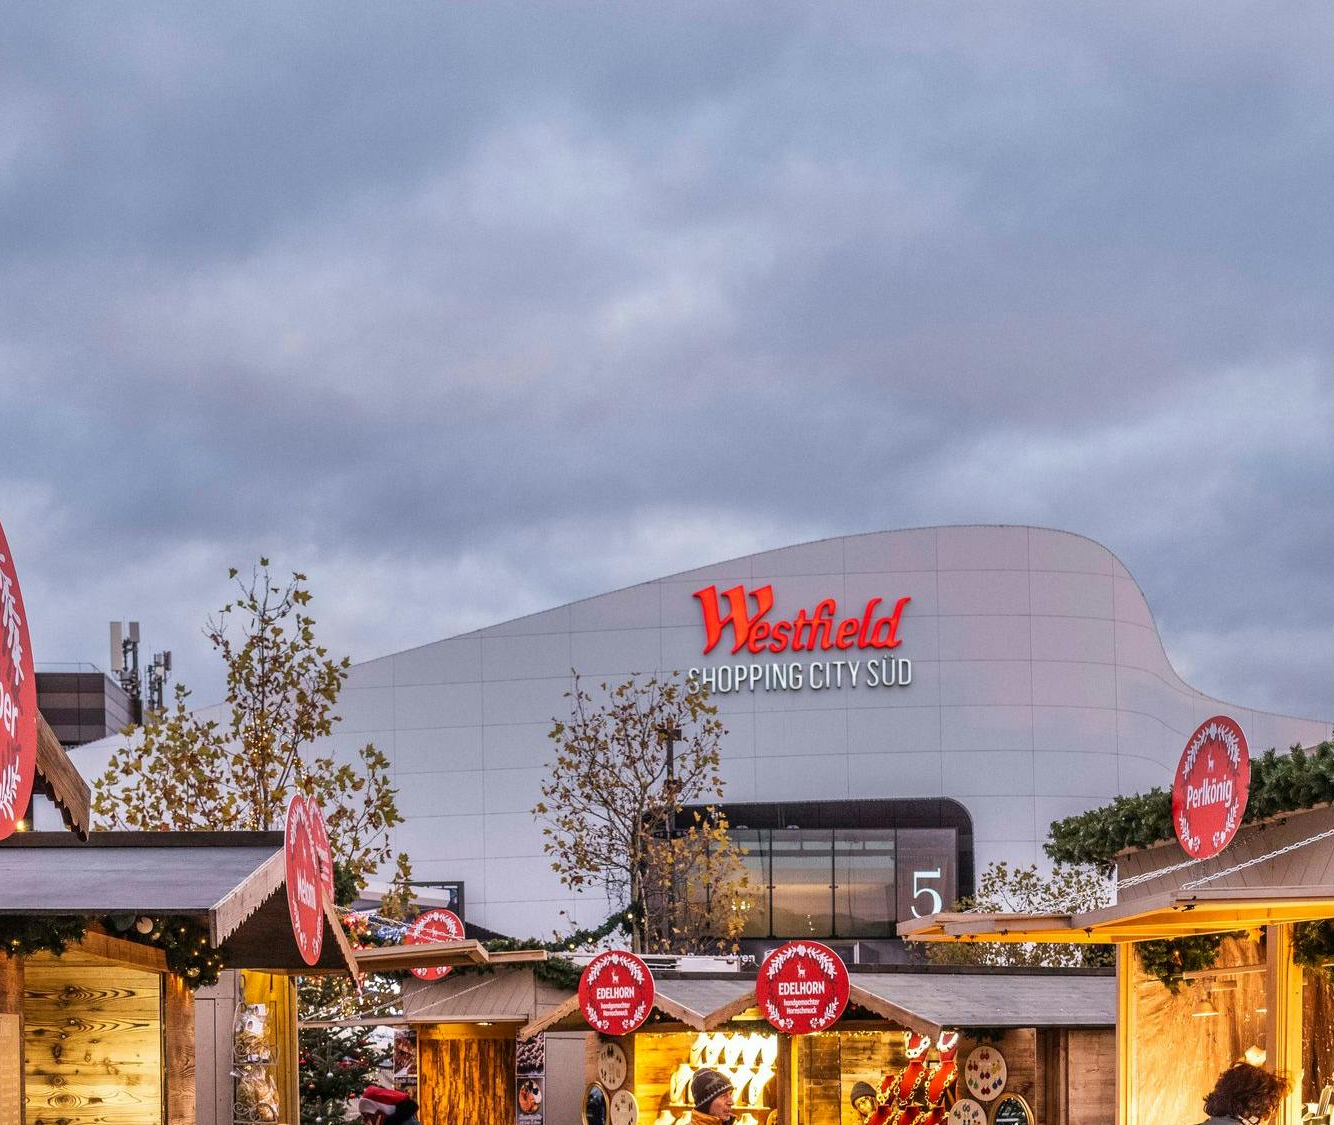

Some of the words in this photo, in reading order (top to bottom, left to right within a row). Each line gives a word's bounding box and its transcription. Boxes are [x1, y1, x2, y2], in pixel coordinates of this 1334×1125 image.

[692, 585, 911, 655] Westfield
[688, 662, 803, 694] SHOPPING
[809, 660, 860, 689] CITY
[867, 655, 912, 688] SÜD
[1187, 774, 1233, 809] Perlkönig
[911, 868, 942, 918] 5
[596, 986, 635, 1000] EDELHORN
[779, 981, 825, 996] EDELHORN
